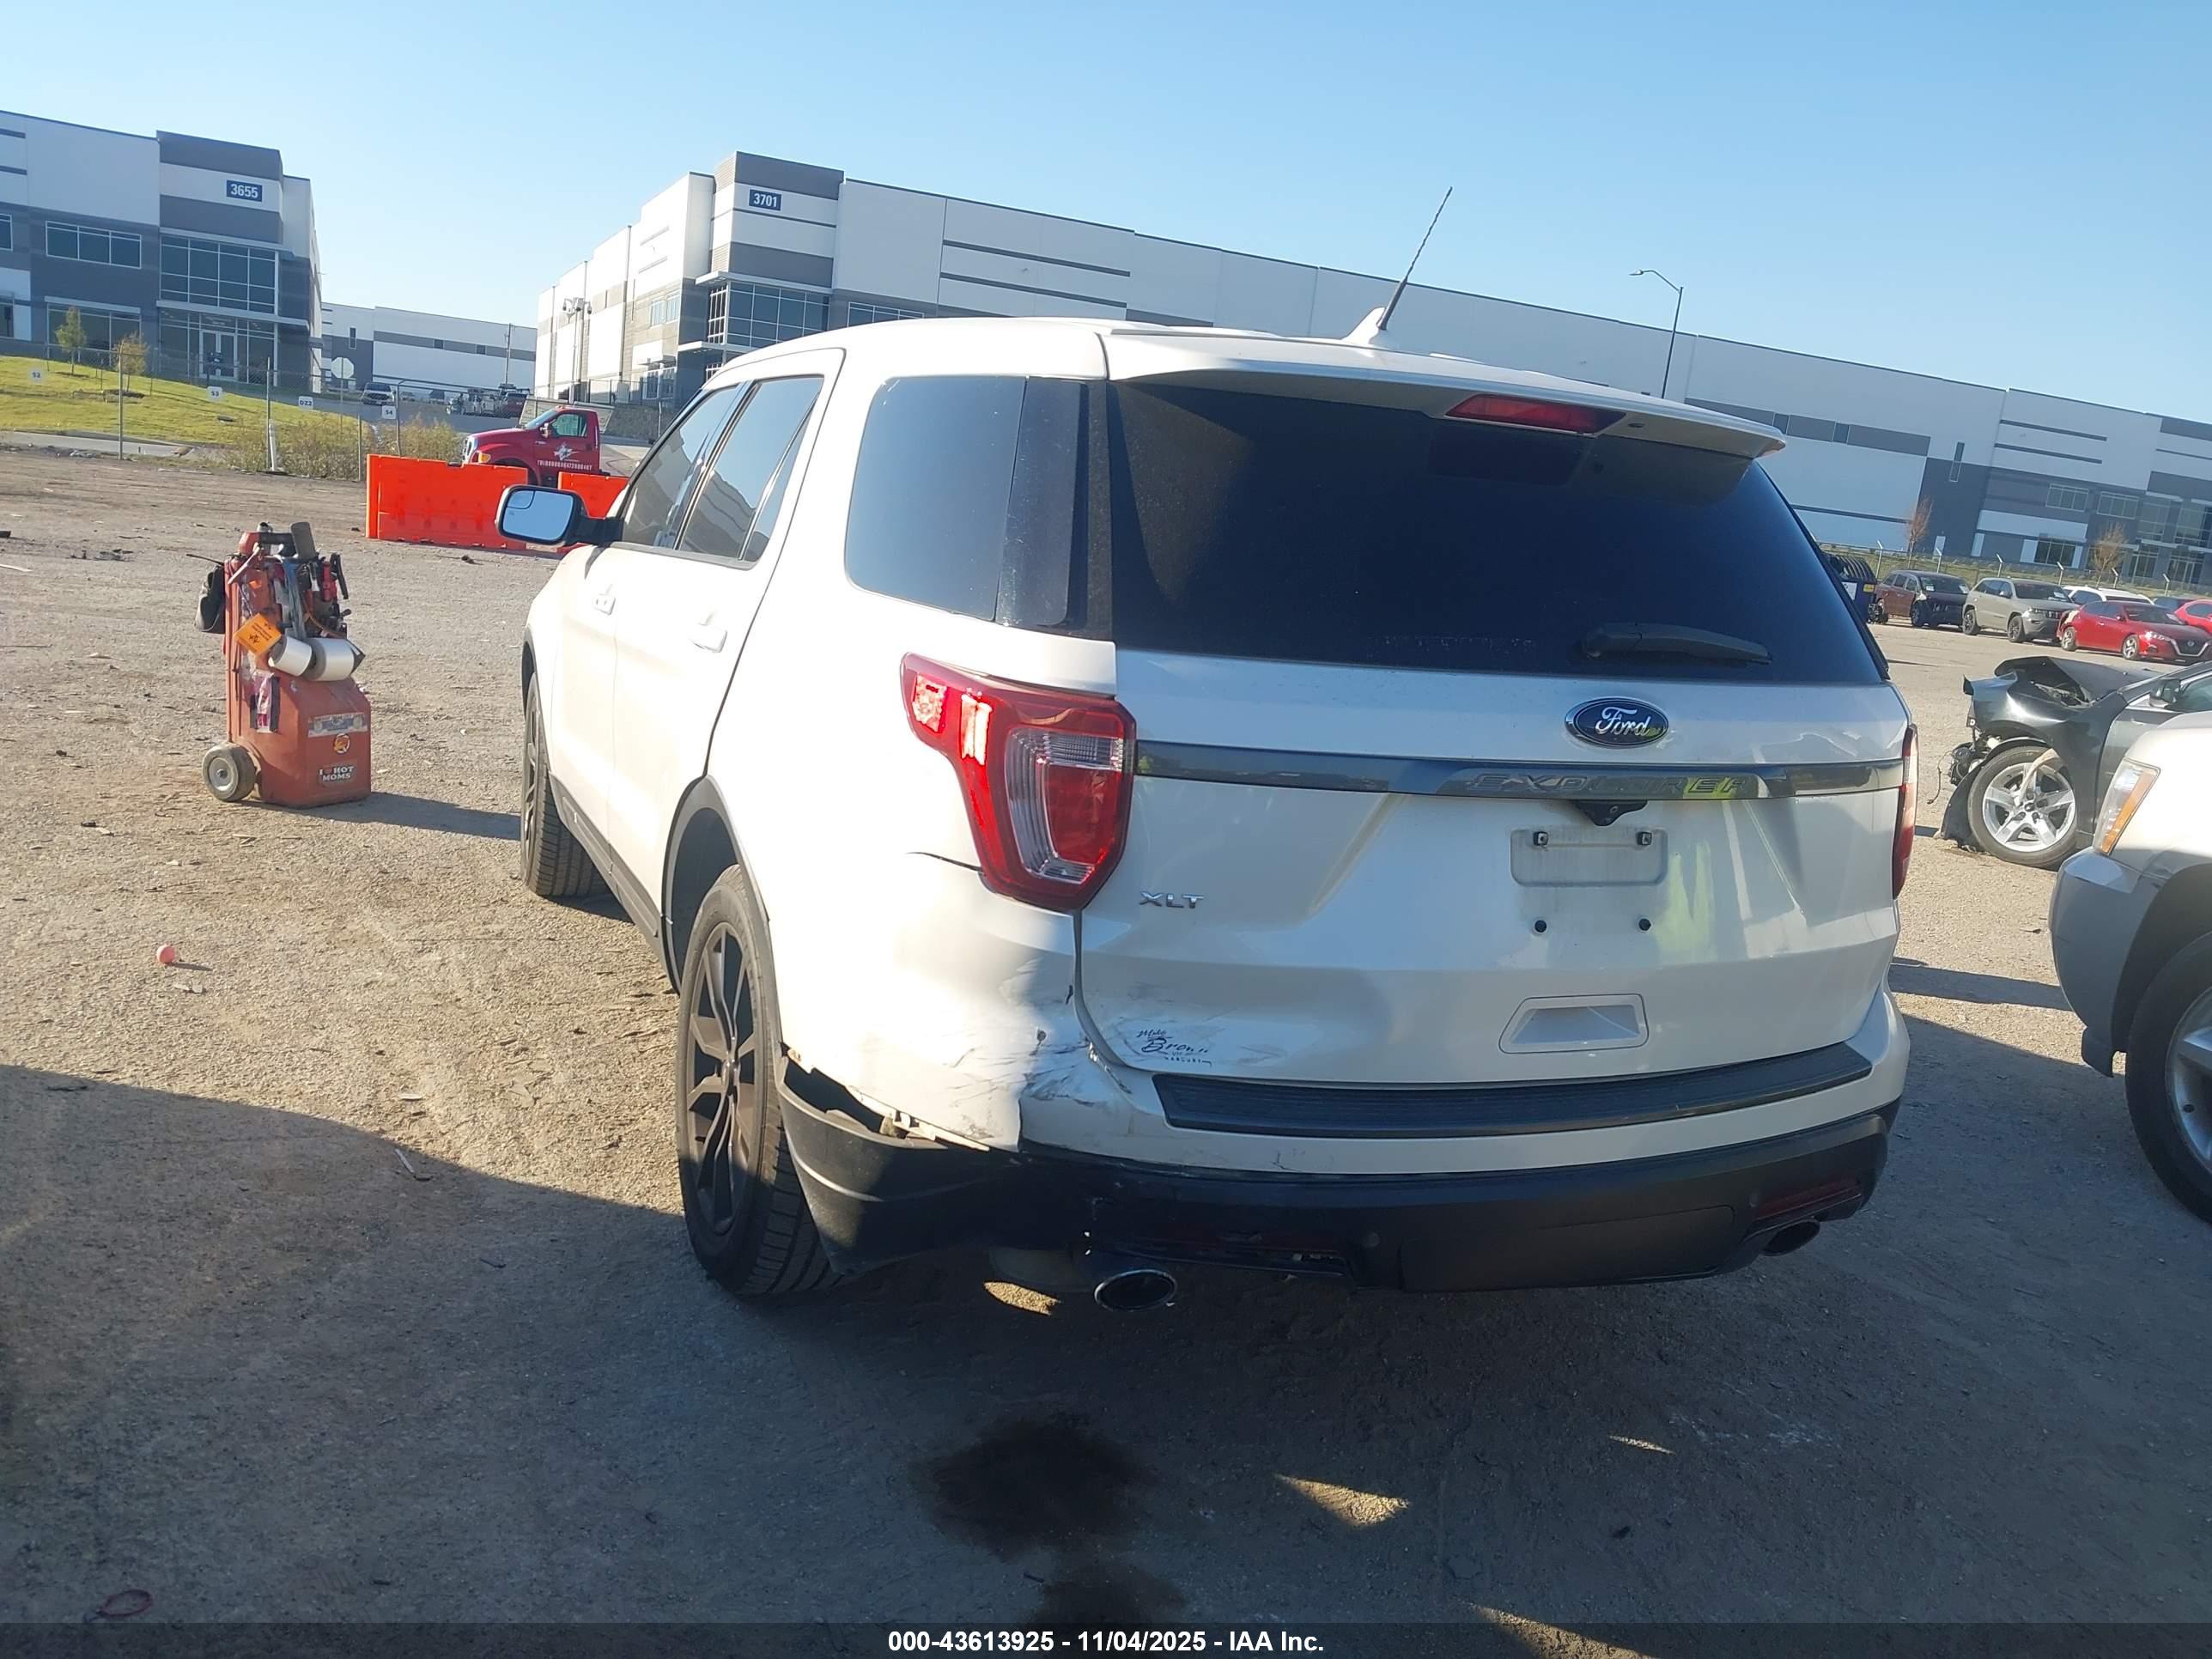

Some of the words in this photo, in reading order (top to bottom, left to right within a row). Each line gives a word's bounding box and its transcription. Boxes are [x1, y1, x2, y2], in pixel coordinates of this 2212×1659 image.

[230, 183, 258, 198] 3655
[753, 192, 778, 208] 3701
[1595, 706, 1651, 737] Ford
[322, 773, 351, 781] MOMS
[1139, 890, 1205, 908] XLT
